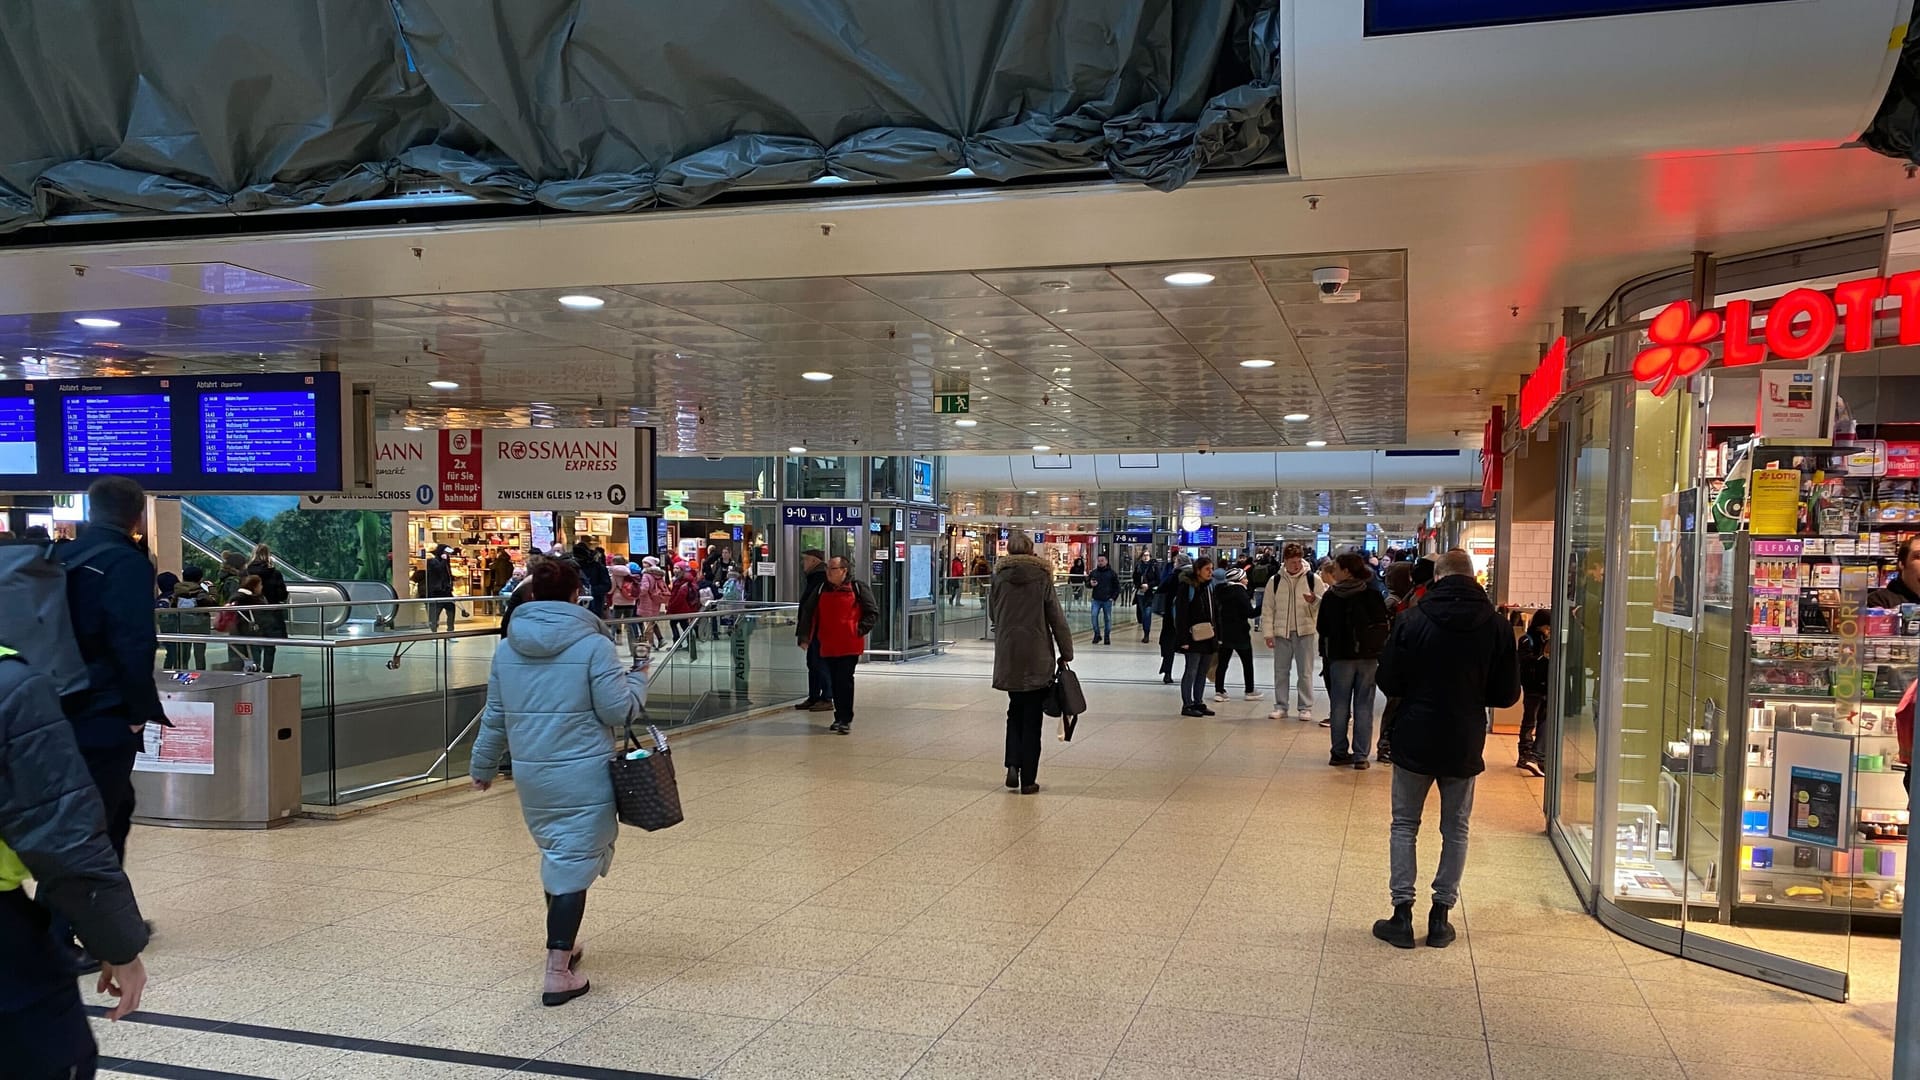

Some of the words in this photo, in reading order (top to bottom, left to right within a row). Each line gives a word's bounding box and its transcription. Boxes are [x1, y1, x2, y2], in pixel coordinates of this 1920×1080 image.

[375, 442, 423, 460] ANN
[498, 440, 618, 460] ROSSMANN
[453, 459, 467, 469] 2x
[564, 460, 618, 471] EXPRESS
[447, 472, 459, 481] für
[461, 472, 474, 480] Sie
[1771, 472, 1797, 480] LOTTO
[443, 483, 454, 491] im
[454, 483, 481, 493] Haupt-
[444, 494, 478, 503] bahnhof
[497, 490, 544, 500] ZWISCHEN
[546, 490, 572, 500] GLEIS
[786, 507, 807, 518] 9-10
